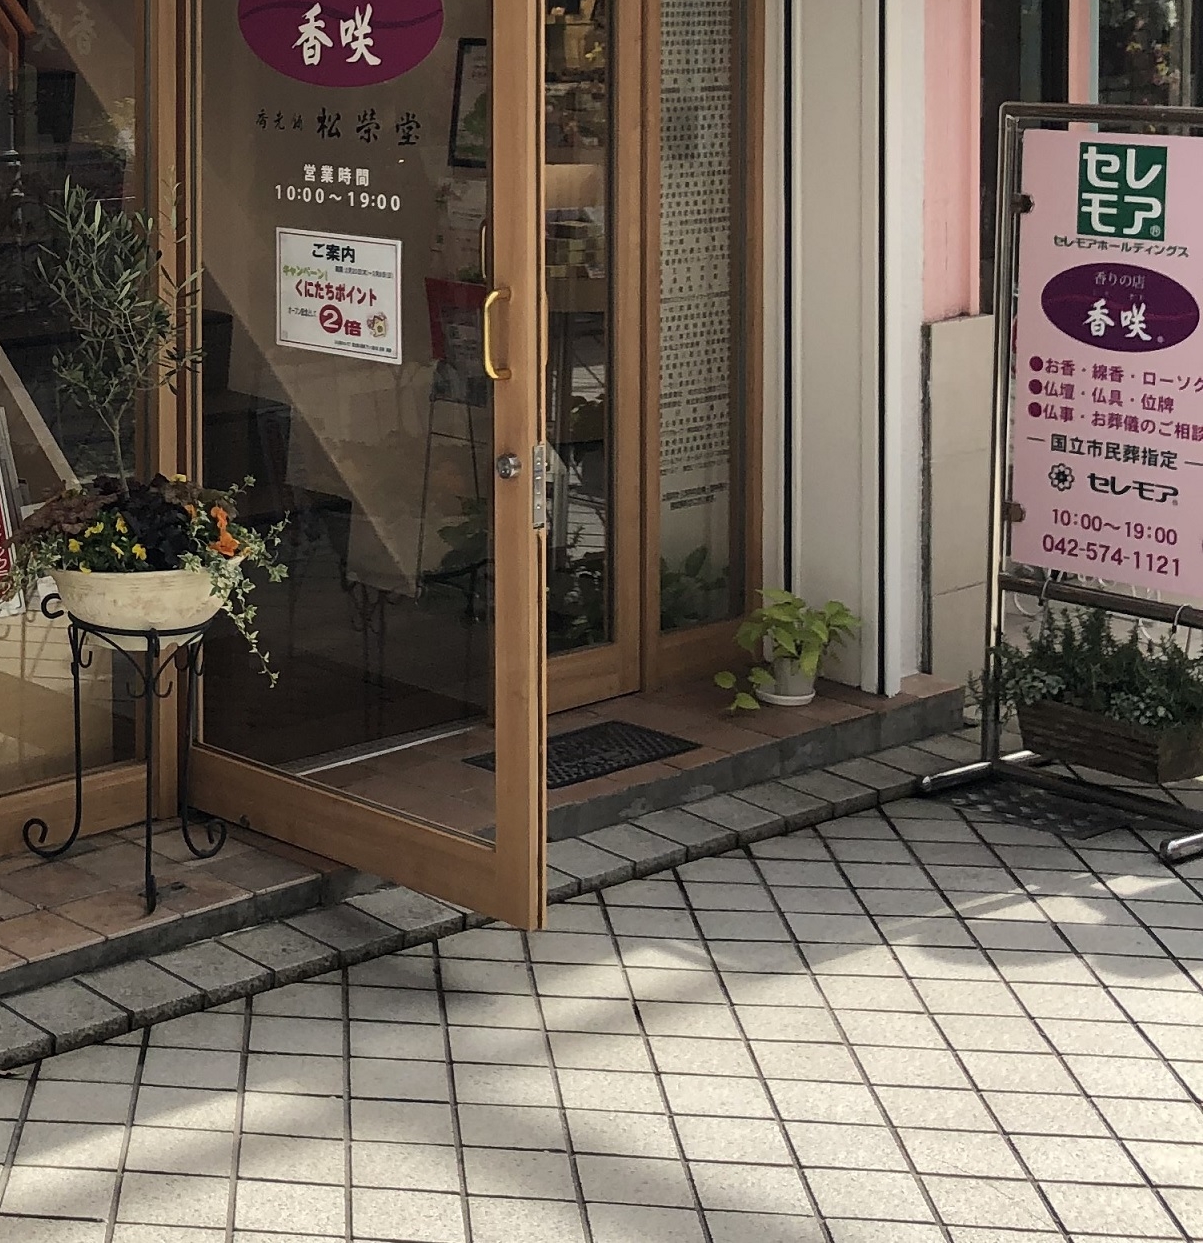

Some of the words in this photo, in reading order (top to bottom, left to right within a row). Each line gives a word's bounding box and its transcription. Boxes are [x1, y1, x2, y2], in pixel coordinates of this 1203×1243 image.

[291, 2, 383, 67] 香咲
[303, 163, 371, 187] 営業時間
[1082, 145, 1163, 189] セレ
[1081, 192, 1162, 236] モア
[312, 243, 356, 264] ご案内
[1053, 234, 1190, 259] セレモアホールディングス
[295, 278, 378, 307] くにたちポイント
[1095, 271, 1146, 290] 香りの店
[1082, 300, 1153, 342] 香咲
[1050, 433, 1179, 471] 国立市民葬指定
[1087, 472, 1179, 504] セレモア
[1042, 534, 1182, 578] 042-574-1121
